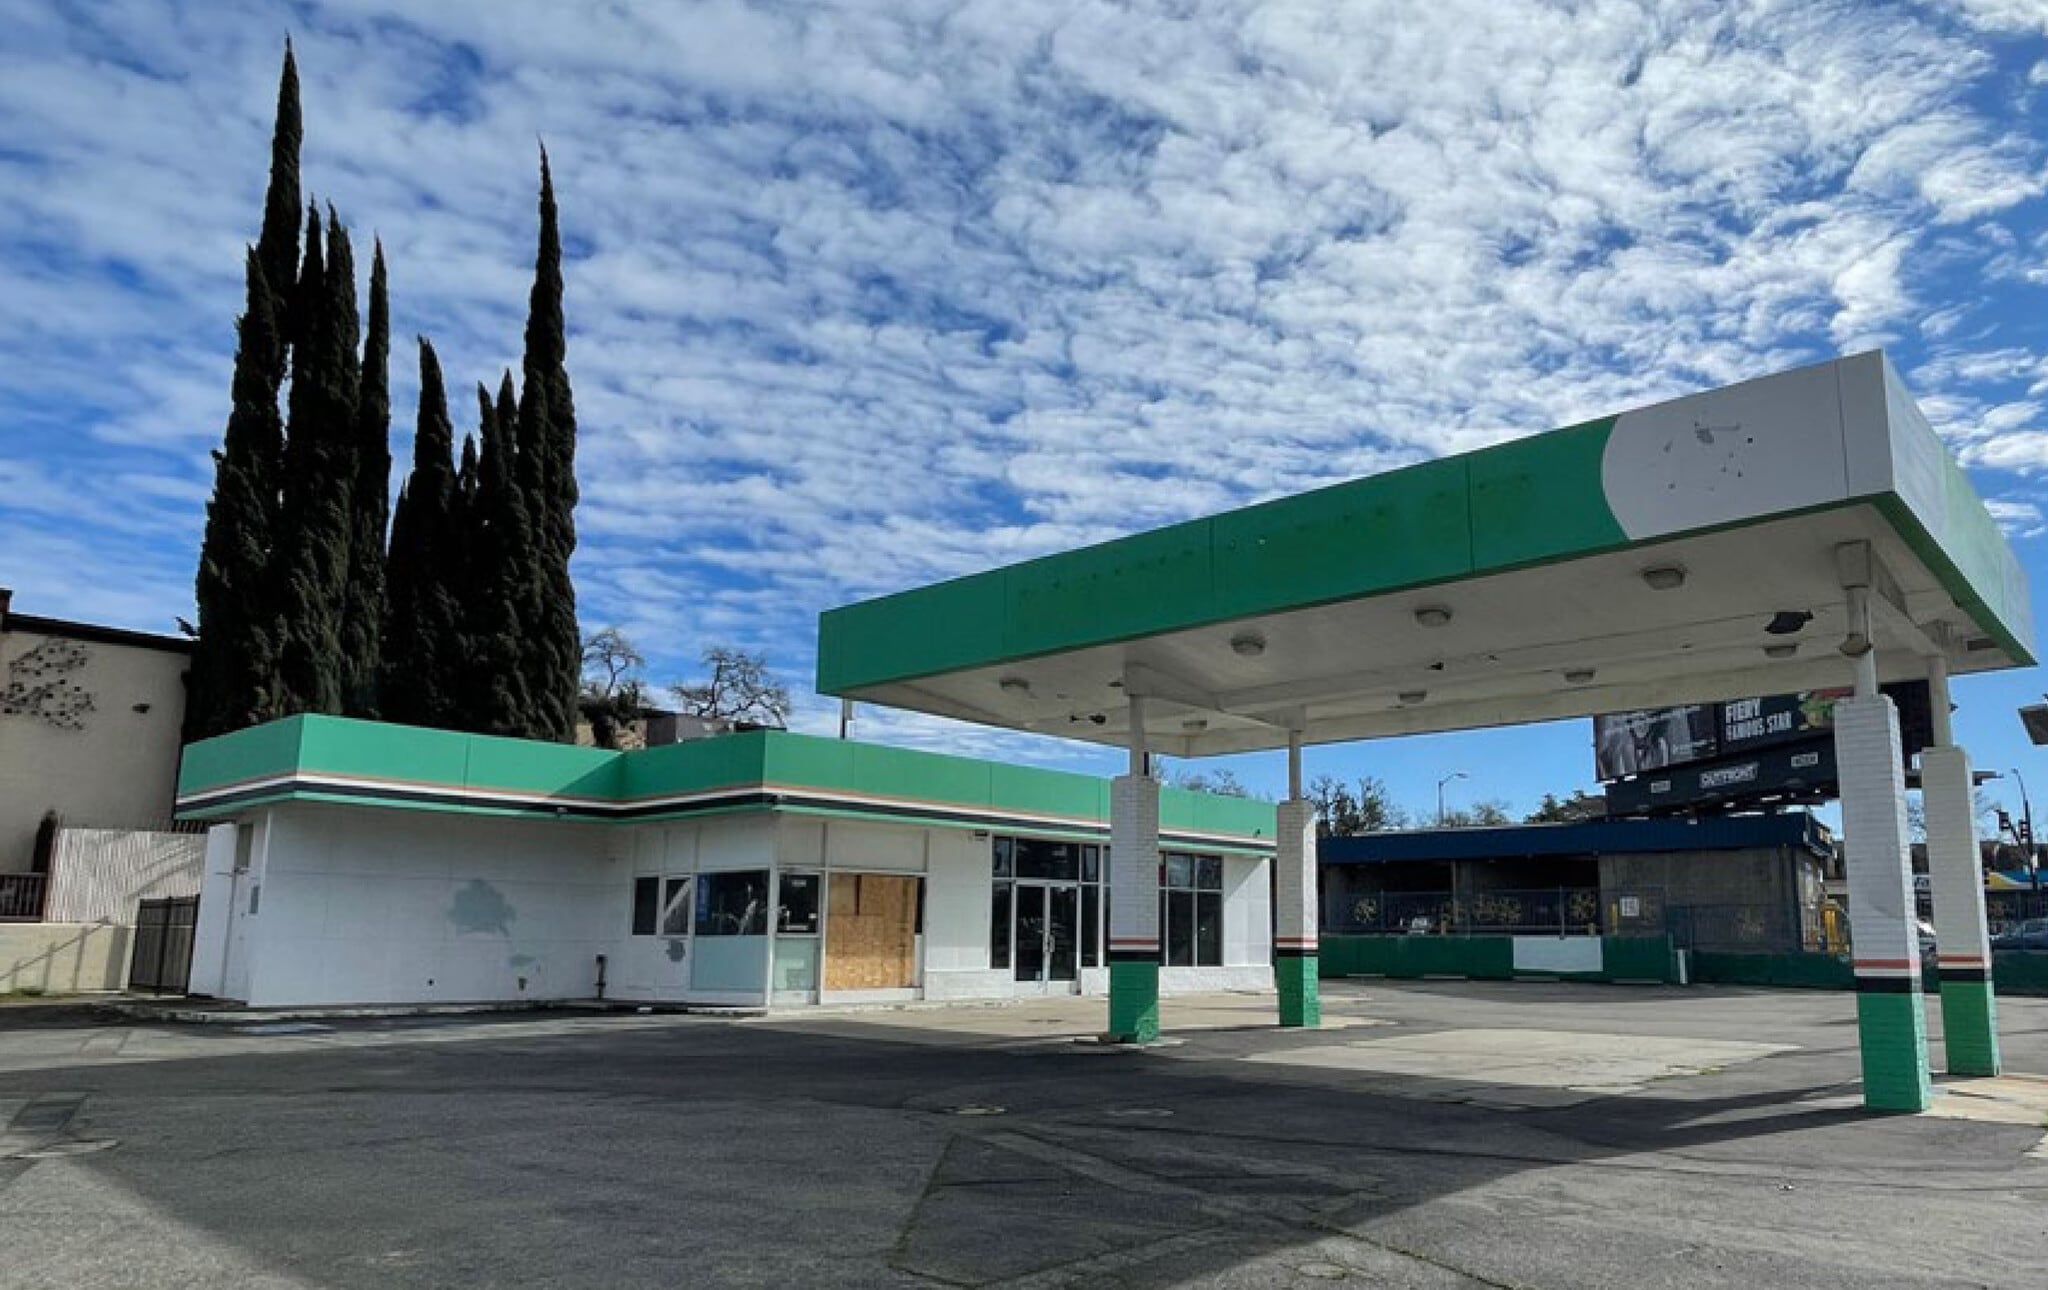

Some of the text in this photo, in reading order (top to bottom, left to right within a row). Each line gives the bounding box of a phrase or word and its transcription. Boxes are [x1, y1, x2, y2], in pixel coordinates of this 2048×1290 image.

[1726, 698, 1760, 724] FIERY
[1726, 711, 1792, 741] FAMOUS STAR
